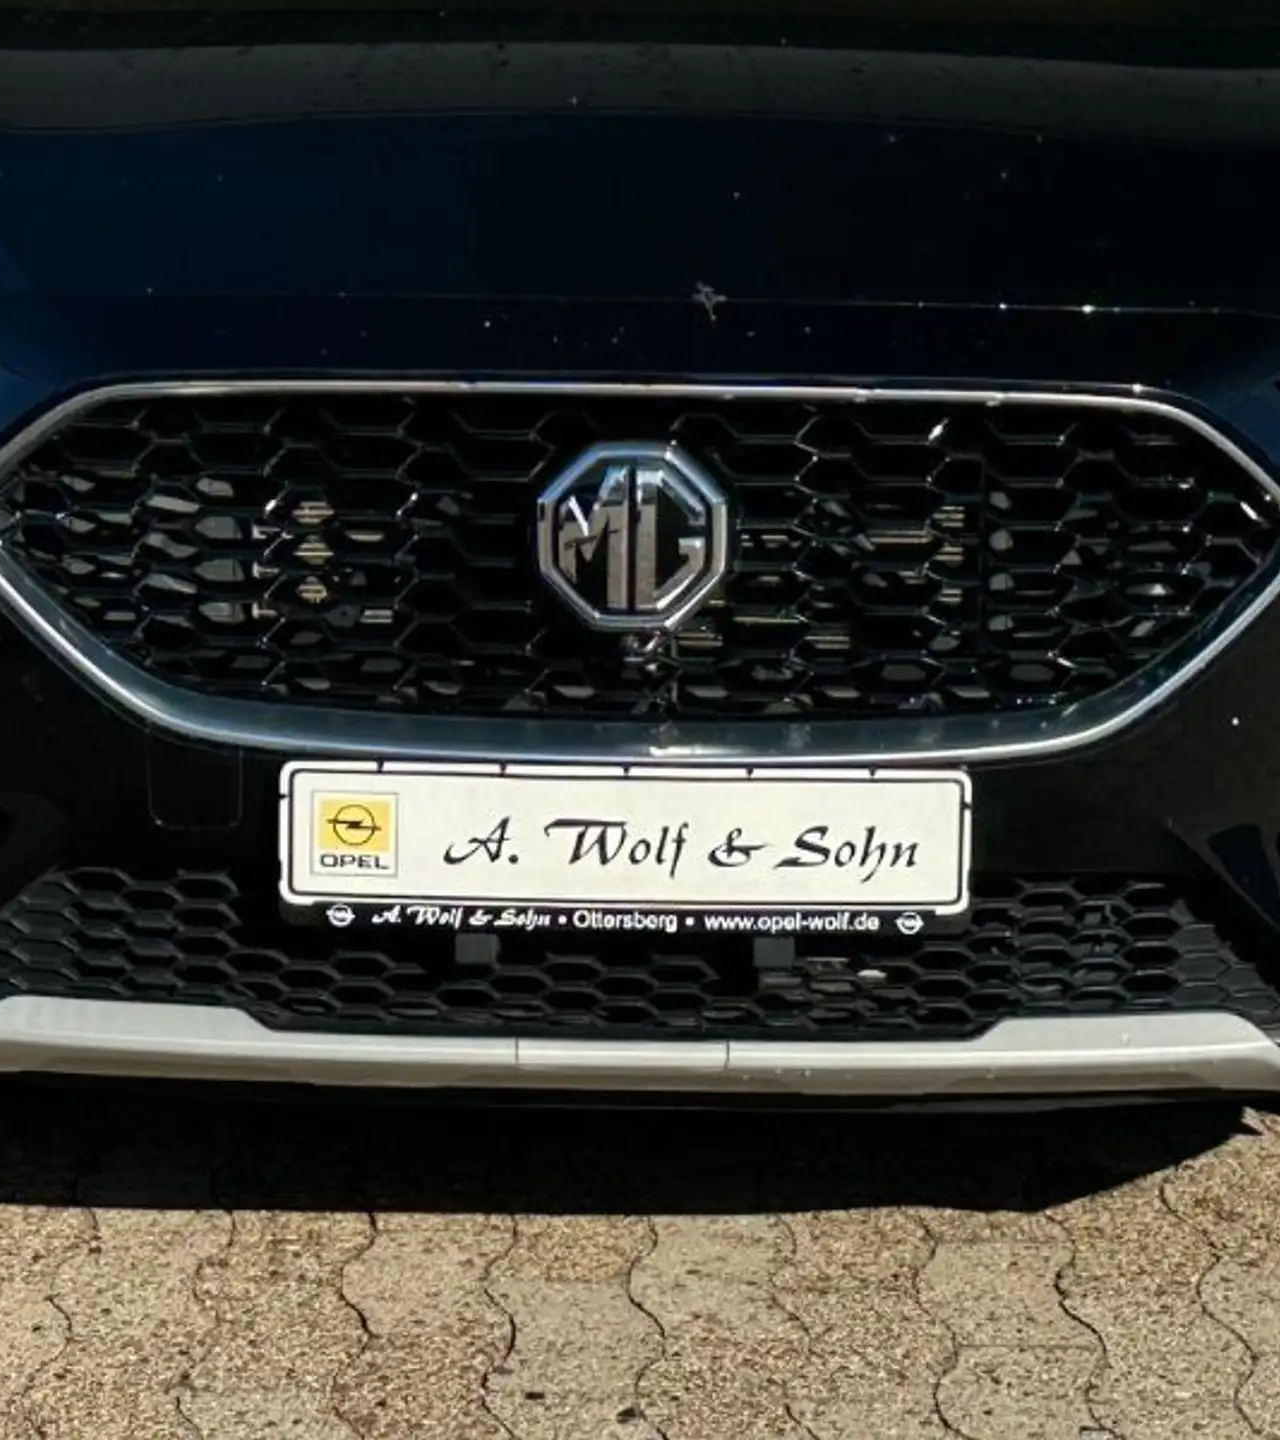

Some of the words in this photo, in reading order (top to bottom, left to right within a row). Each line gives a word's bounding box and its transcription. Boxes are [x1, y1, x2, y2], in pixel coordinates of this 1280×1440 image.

[558, 465, 706, 610] MG
[320, 853, 390, 871] OPEL
[442, 814, 519, 865] A.
[543, 817, 690, 879] Wolf
[706, 827, 773, 868] &
[773, 824, 920, 884] Sohn
[572, 909, 678, 933] Ottersberg
[703, 911, 880, 934] www.opel-wolf.de
